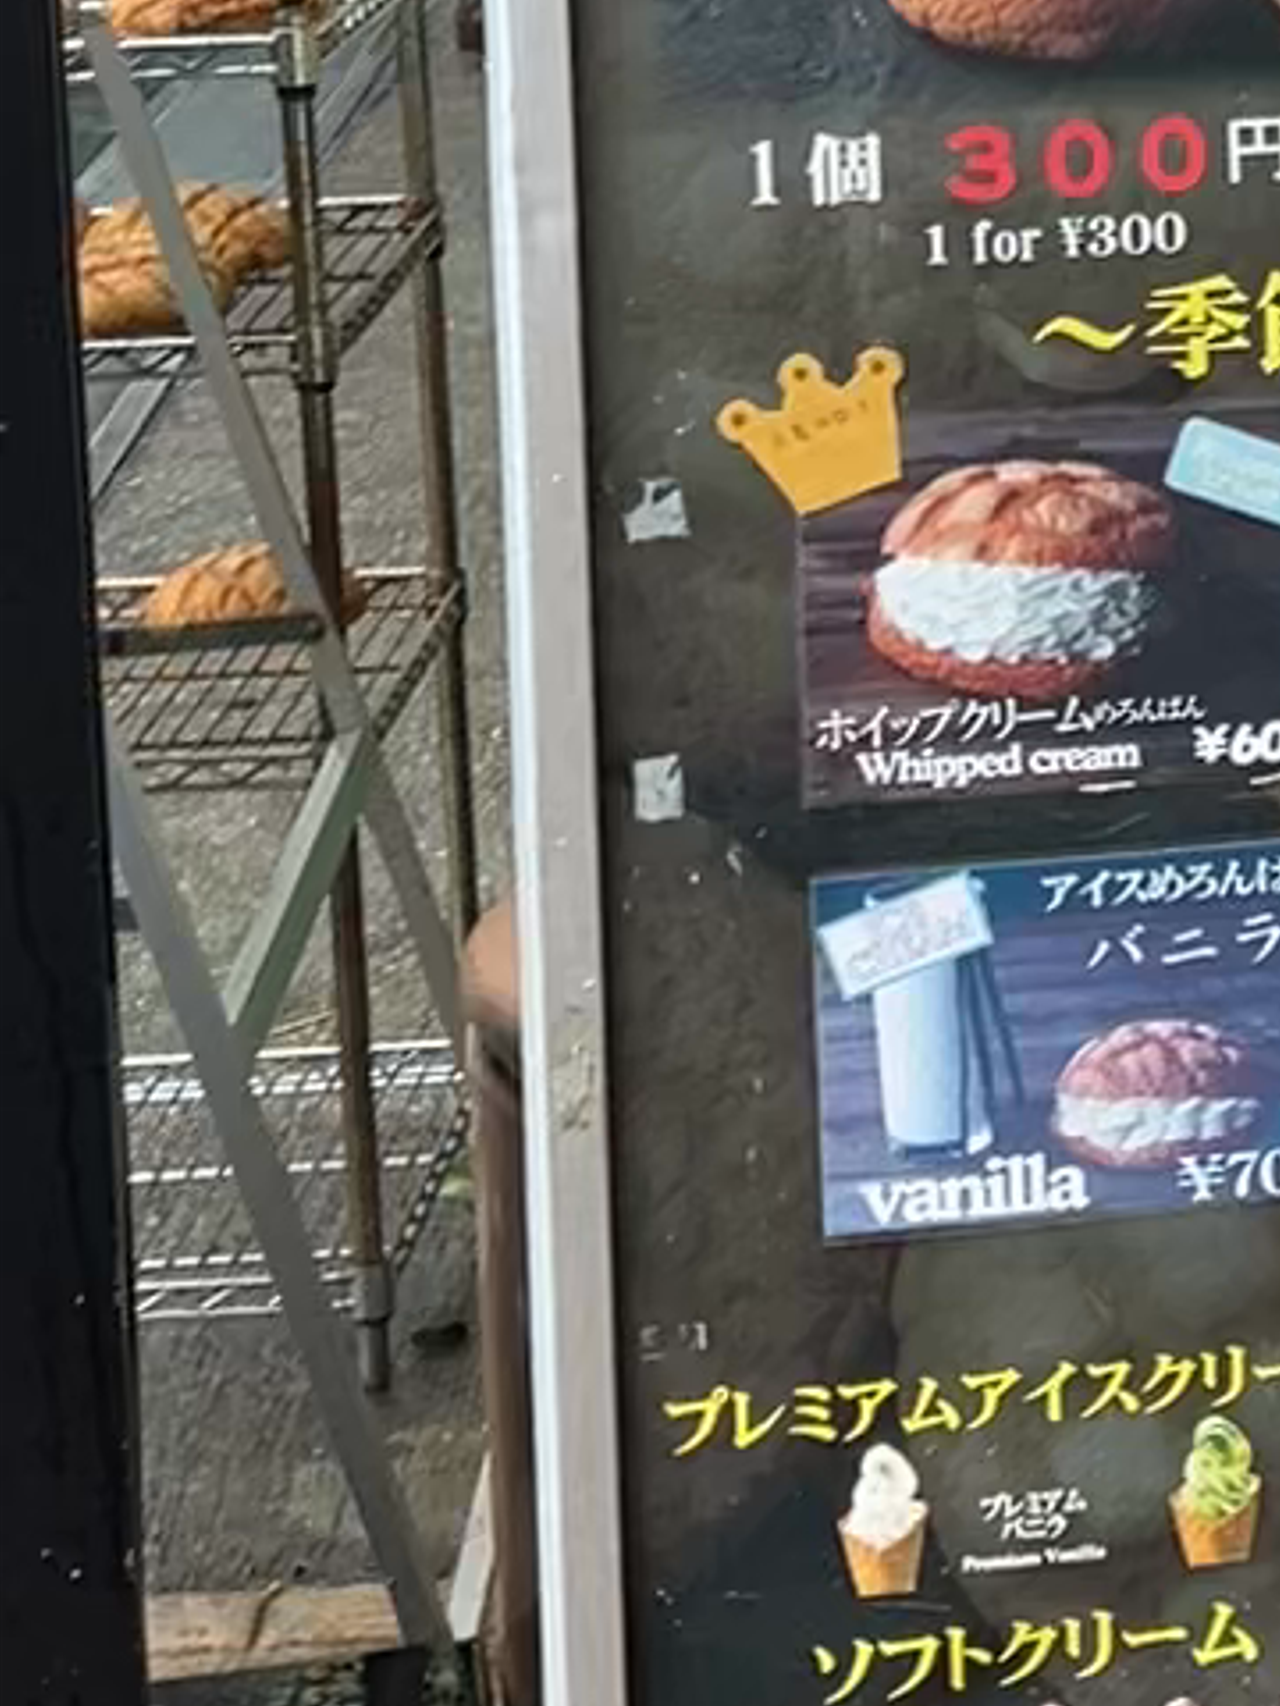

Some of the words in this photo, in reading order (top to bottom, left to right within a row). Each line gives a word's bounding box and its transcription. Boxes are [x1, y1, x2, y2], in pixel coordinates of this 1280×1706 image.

[749, 131, 883, 207] 1個
[925, 223, 949, 266] 1
[972, 219, 1043, 263] for
[1058, 211, 1188, 257] ¥300
[856, 744, 1022, 790] Whipped
[1029, 744, 1141, 773] cream
[860, 1152, 1090, 1225] vanilla
[813, 1600, 1260, 1706] ソフトクリーム
